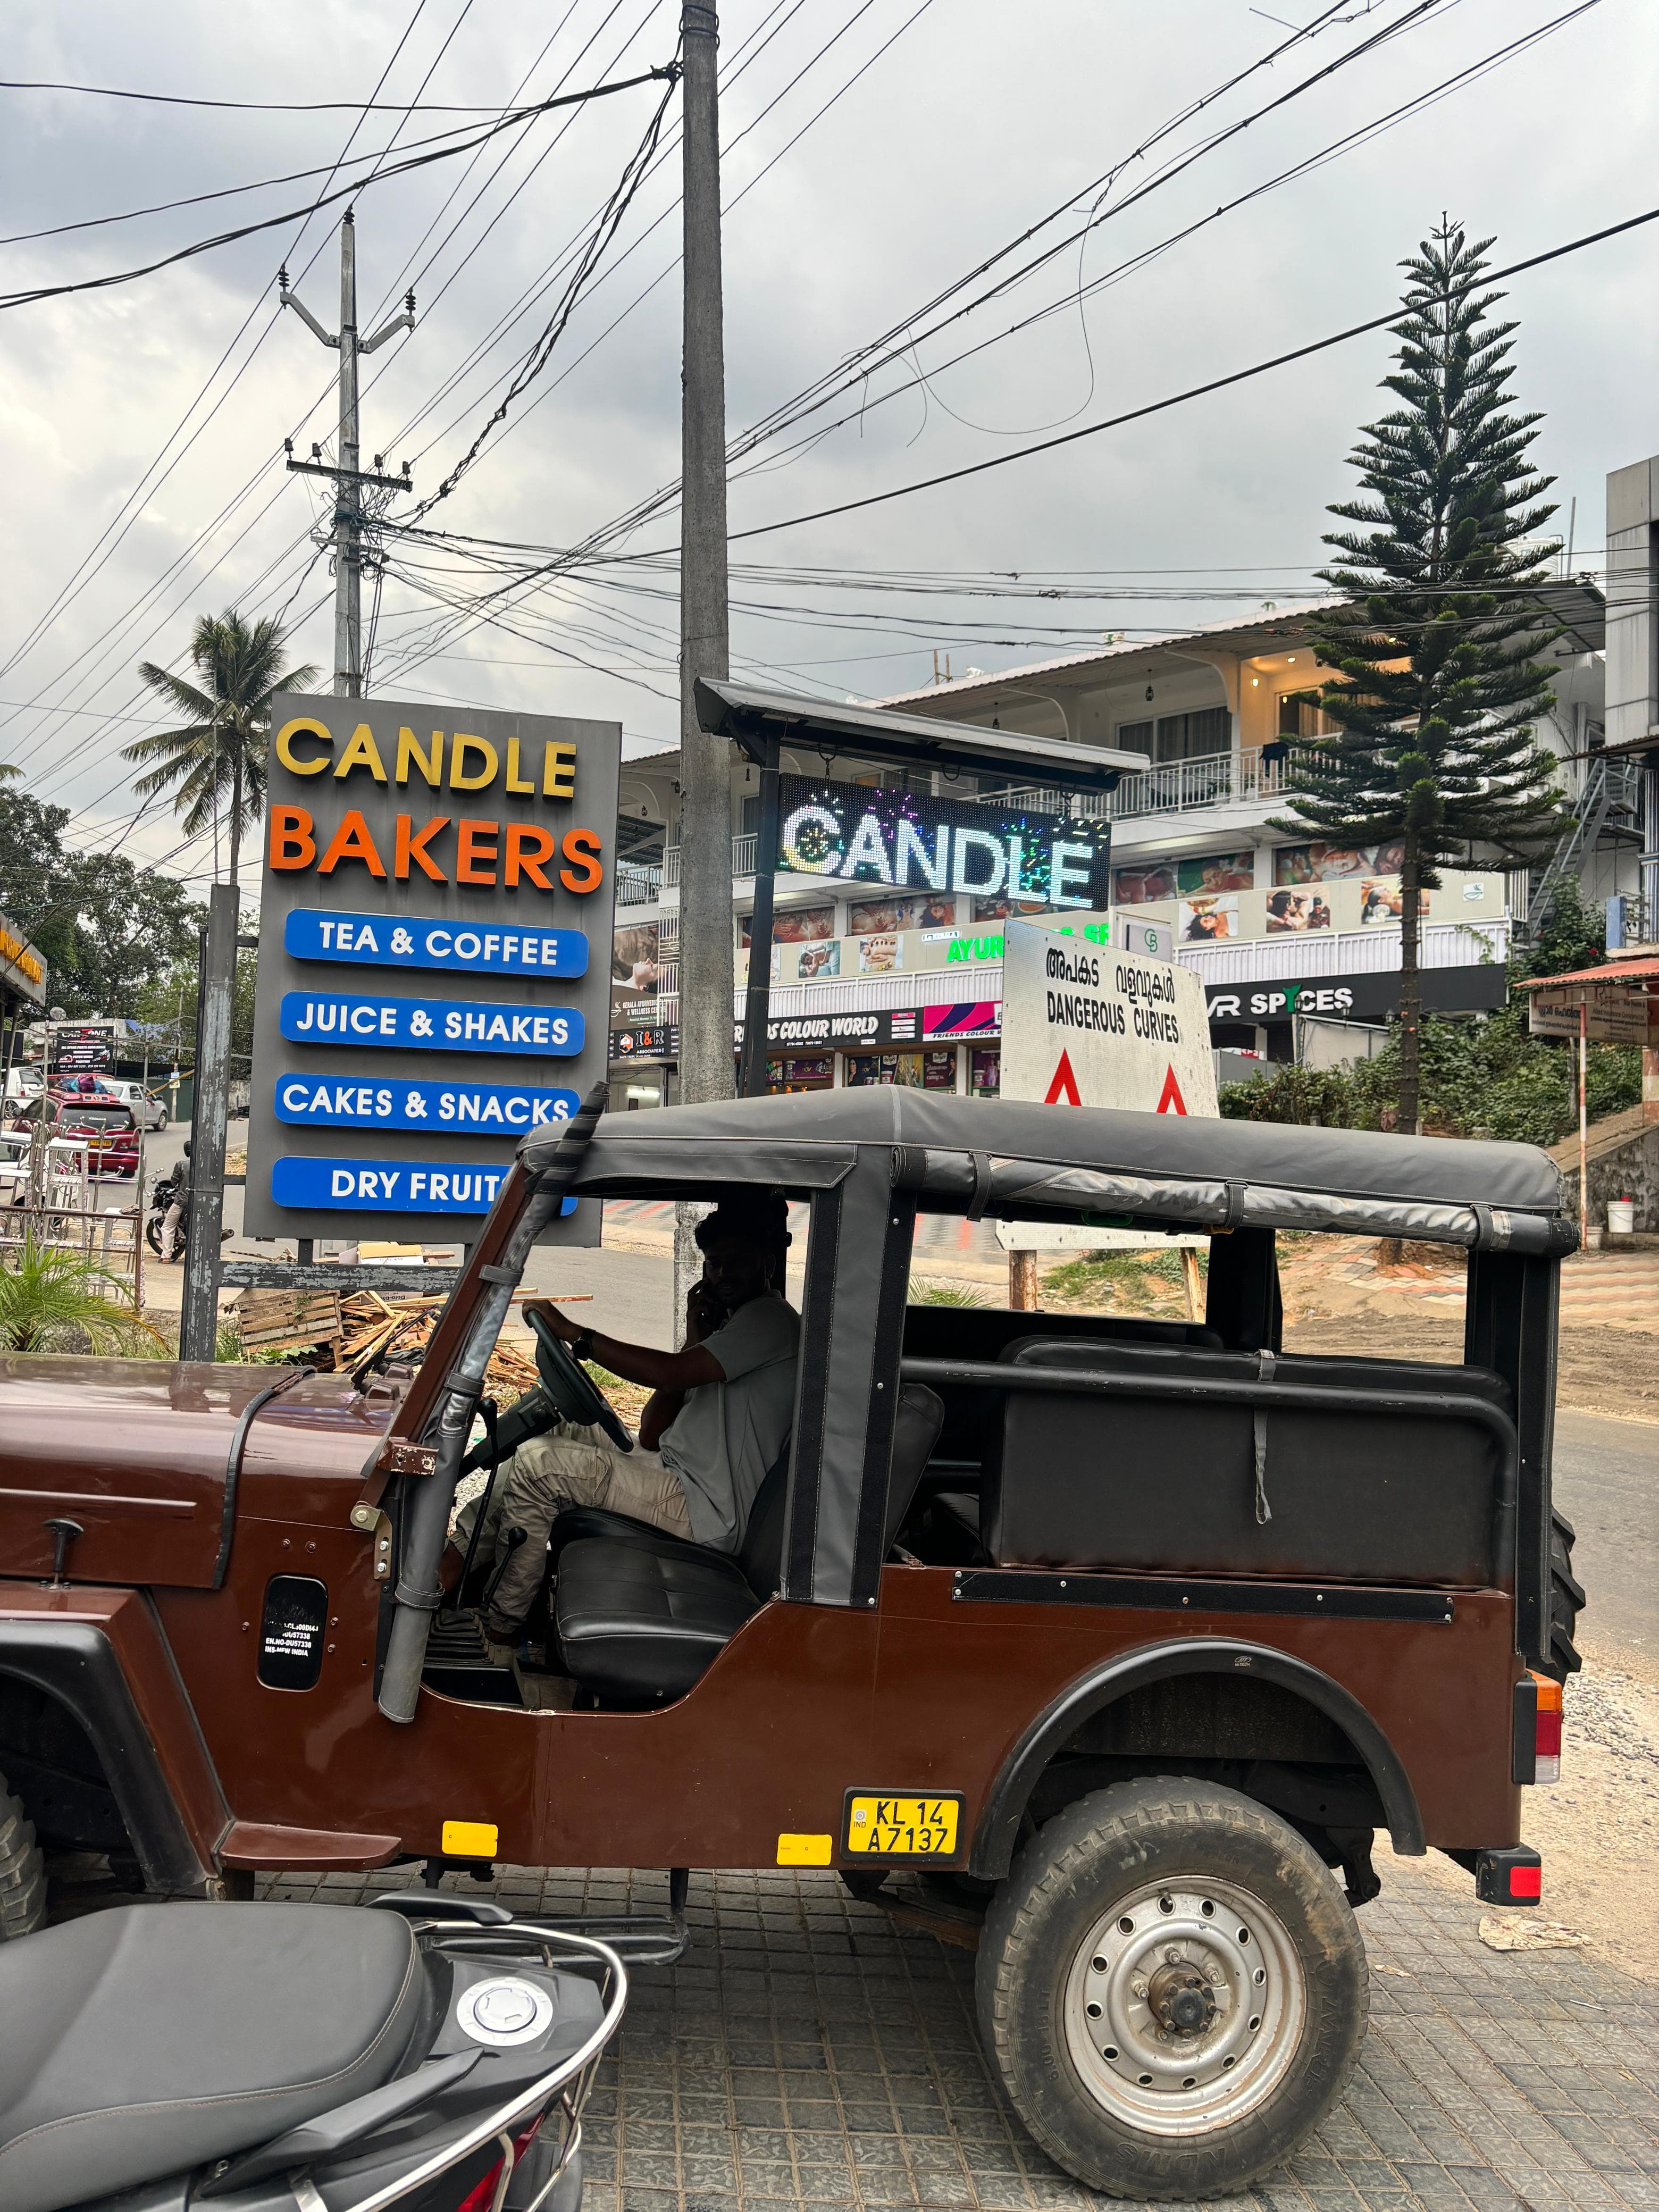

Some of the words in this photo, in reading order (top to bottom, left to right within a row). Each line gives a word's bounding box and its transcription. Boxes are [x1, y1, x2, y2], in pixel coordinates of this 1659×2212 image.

[276, 717, 576, 798] CANDLE
[269, 804, 603, 893] BAKERS
[783, 805, 1094, 909] CANDLE
[319, 921, 379, 952] TEA
[390, 927, 414, 954] &
[426, 929, 558, 966] COFFEE
[1046, 948, 1099, 987] അപകട
[296, 1003, 397, 1035] JUICE
[410, 1010, 434, 1037] &
[445, 1012, 568, 1045] SHAKES
[780, 1019, 830, 1040] COLOUR
[832, 1016, 879, 1036] WORLD
[1047, 991, 1125, 1035] DANGEROUS
[1134, 1007, 1179, 1044] CURVES
[635, 1030, 664, 1047] I&R
[282, 1084, 392, 1116] CAKES
[405, 1091, 428, 1118] &
[439, 1093, 568, 1125] SNACKS
[331, 1170, 400, 1199] DRY
[410, 1174, 505, 1202] FRUIT
[291, 1648, 308, 1657] INDIA
[877, 1801, 905, 1824] KL
[917, 1802, 943, 1825] 14
